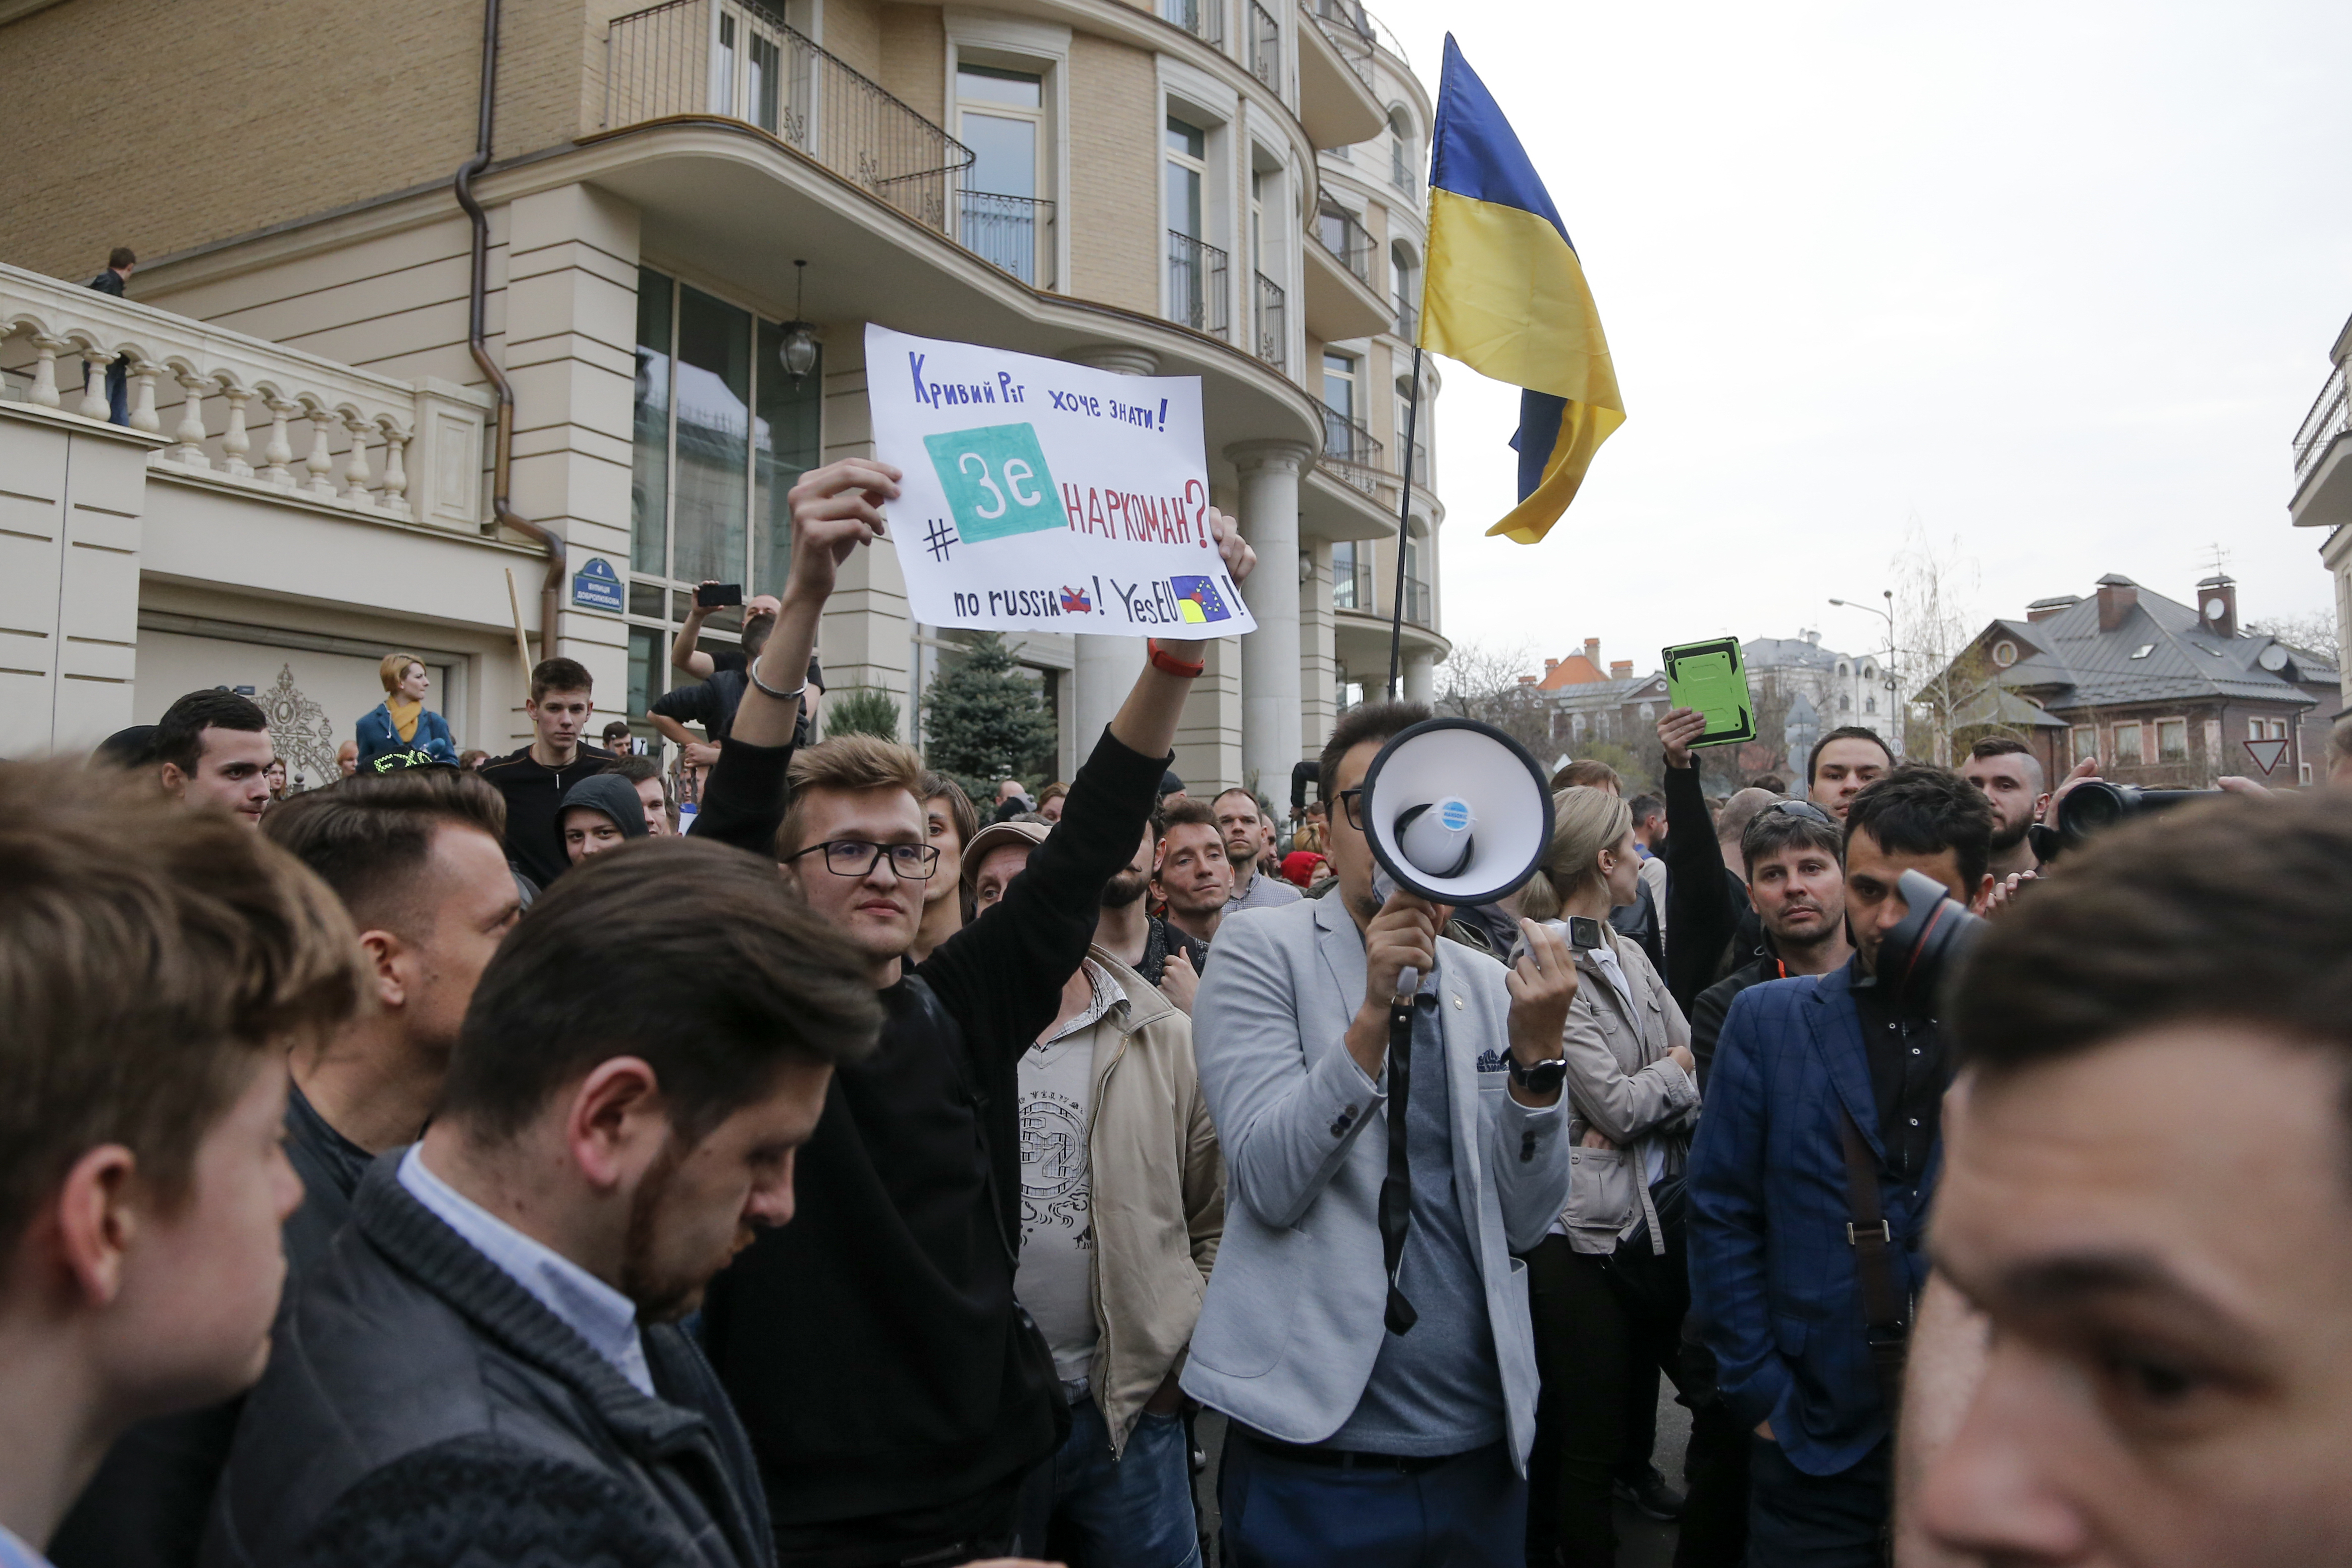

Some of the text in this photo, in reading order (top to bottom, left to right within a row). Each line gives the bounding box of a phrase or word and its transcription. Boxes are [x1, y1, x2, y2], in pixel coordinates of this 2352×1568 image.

[909, 351, 996, 409] Кривий
[998, 372, 1025, 403] Ріг
[1048, 390, 1101, 416] хоче
[1063, 479, 1208, 548] НАРКОМАН?
[596, 564, 603, 575] 4
[954, 591, 979, 616] no
